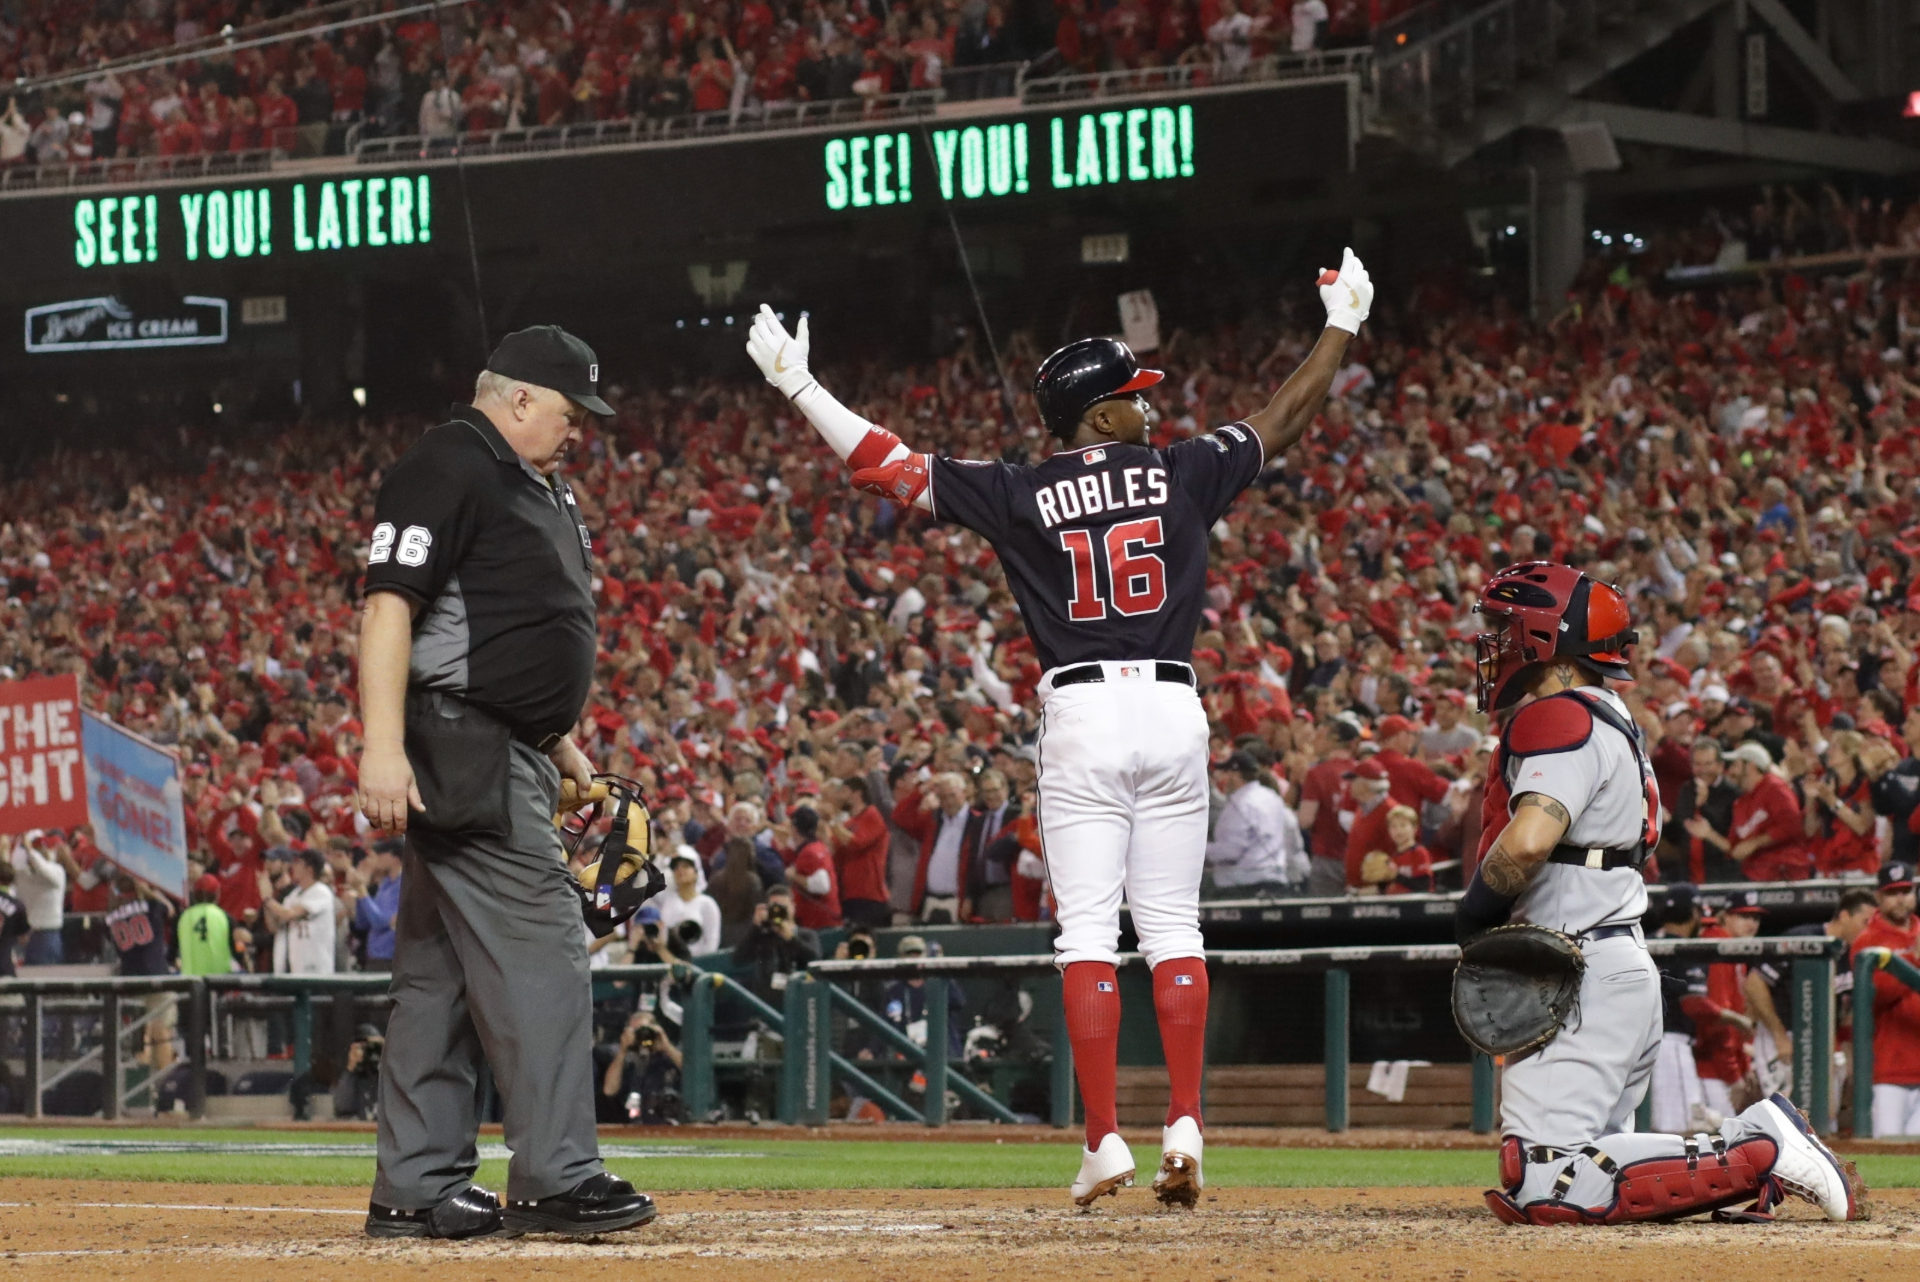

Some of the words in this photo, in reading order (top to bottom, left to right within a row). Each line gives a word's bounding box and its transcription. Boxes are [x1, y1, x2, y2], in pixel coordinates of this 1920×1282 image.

[825, 132, 912, 210] SEE!
[932, 122, 1029, 200] YOU!
[1050, 104, 1194, 189] LATER!
[75, 195, 158, 268] SEE!
[179, 188, 271, 260] YOU!
[293, 174, 431, 251] LATER!
[107, 321, 133, 339] ICE
[138, 318, 198, 337] CREAM
[1036, 468, 1168, 528] ROBLES
[368, 522, 432, 567] 26
[1059, 516, 1167, 621] 16
[112, 914, 154, 951] 00
[192, 916, 208, 942] 4
[805, 997, 817, 1109] nationals.com
